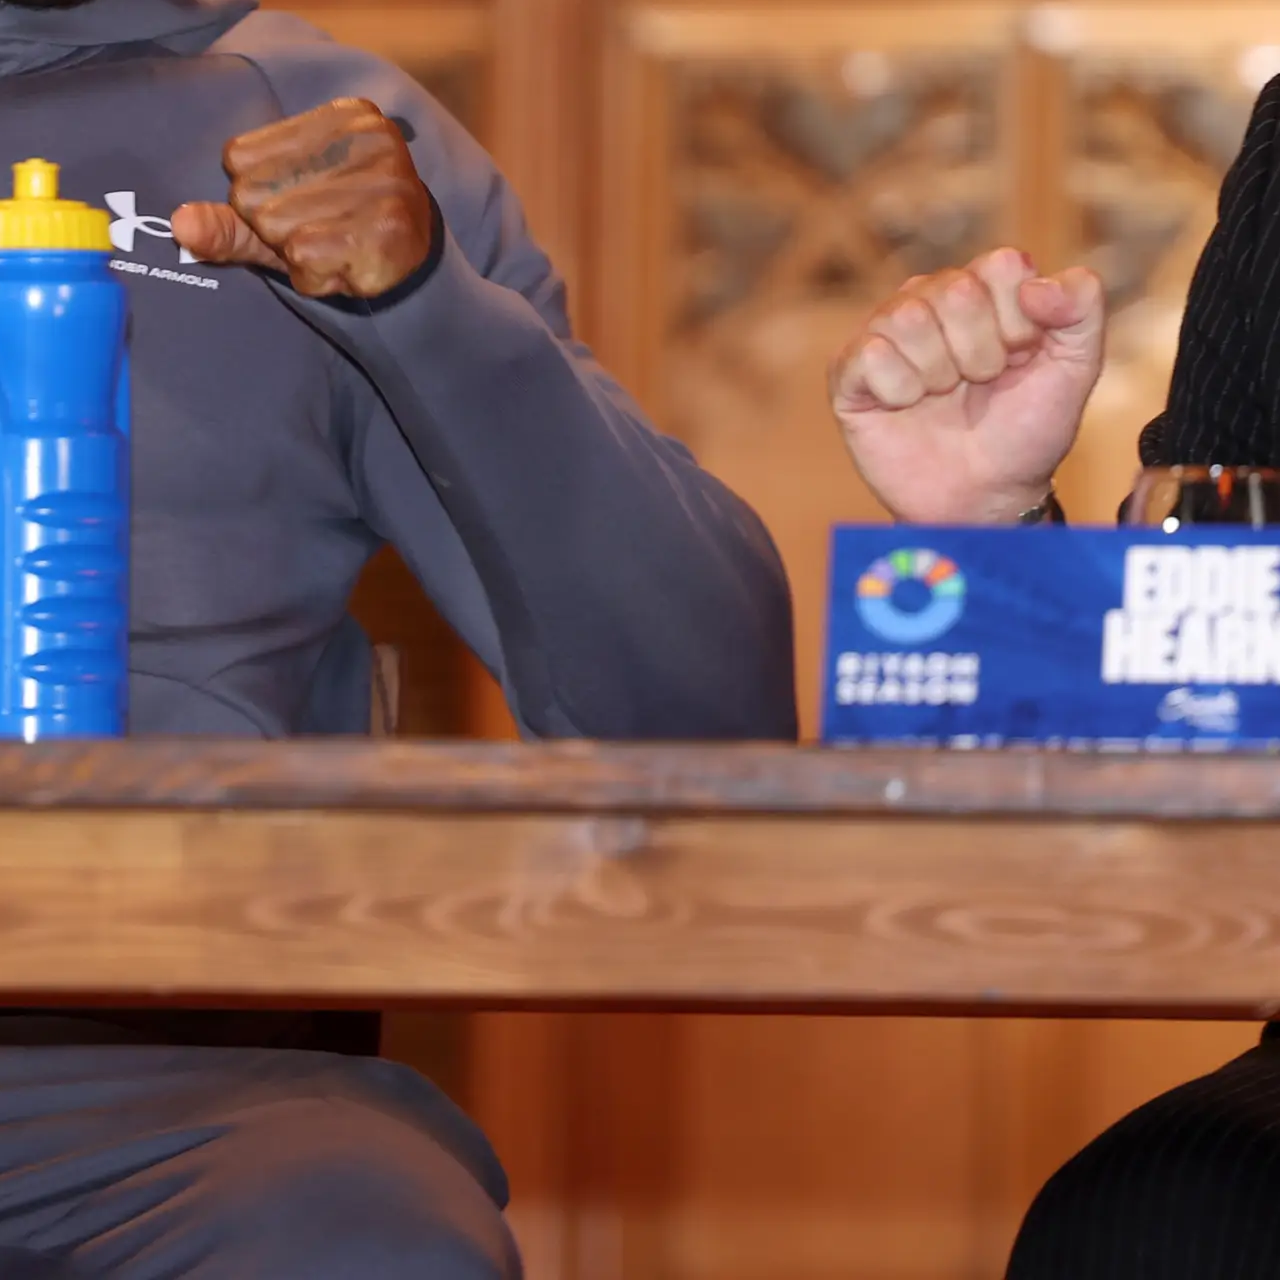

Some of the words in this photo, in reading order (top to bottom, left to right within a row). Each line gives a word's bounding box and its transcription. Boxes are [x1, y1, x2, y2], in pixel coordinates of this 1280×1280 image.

[148, 267, 220, 290] ARMOUR
[836, 651, 980, 677] RIYADH
[835, 678, 979, 706] SEASON
